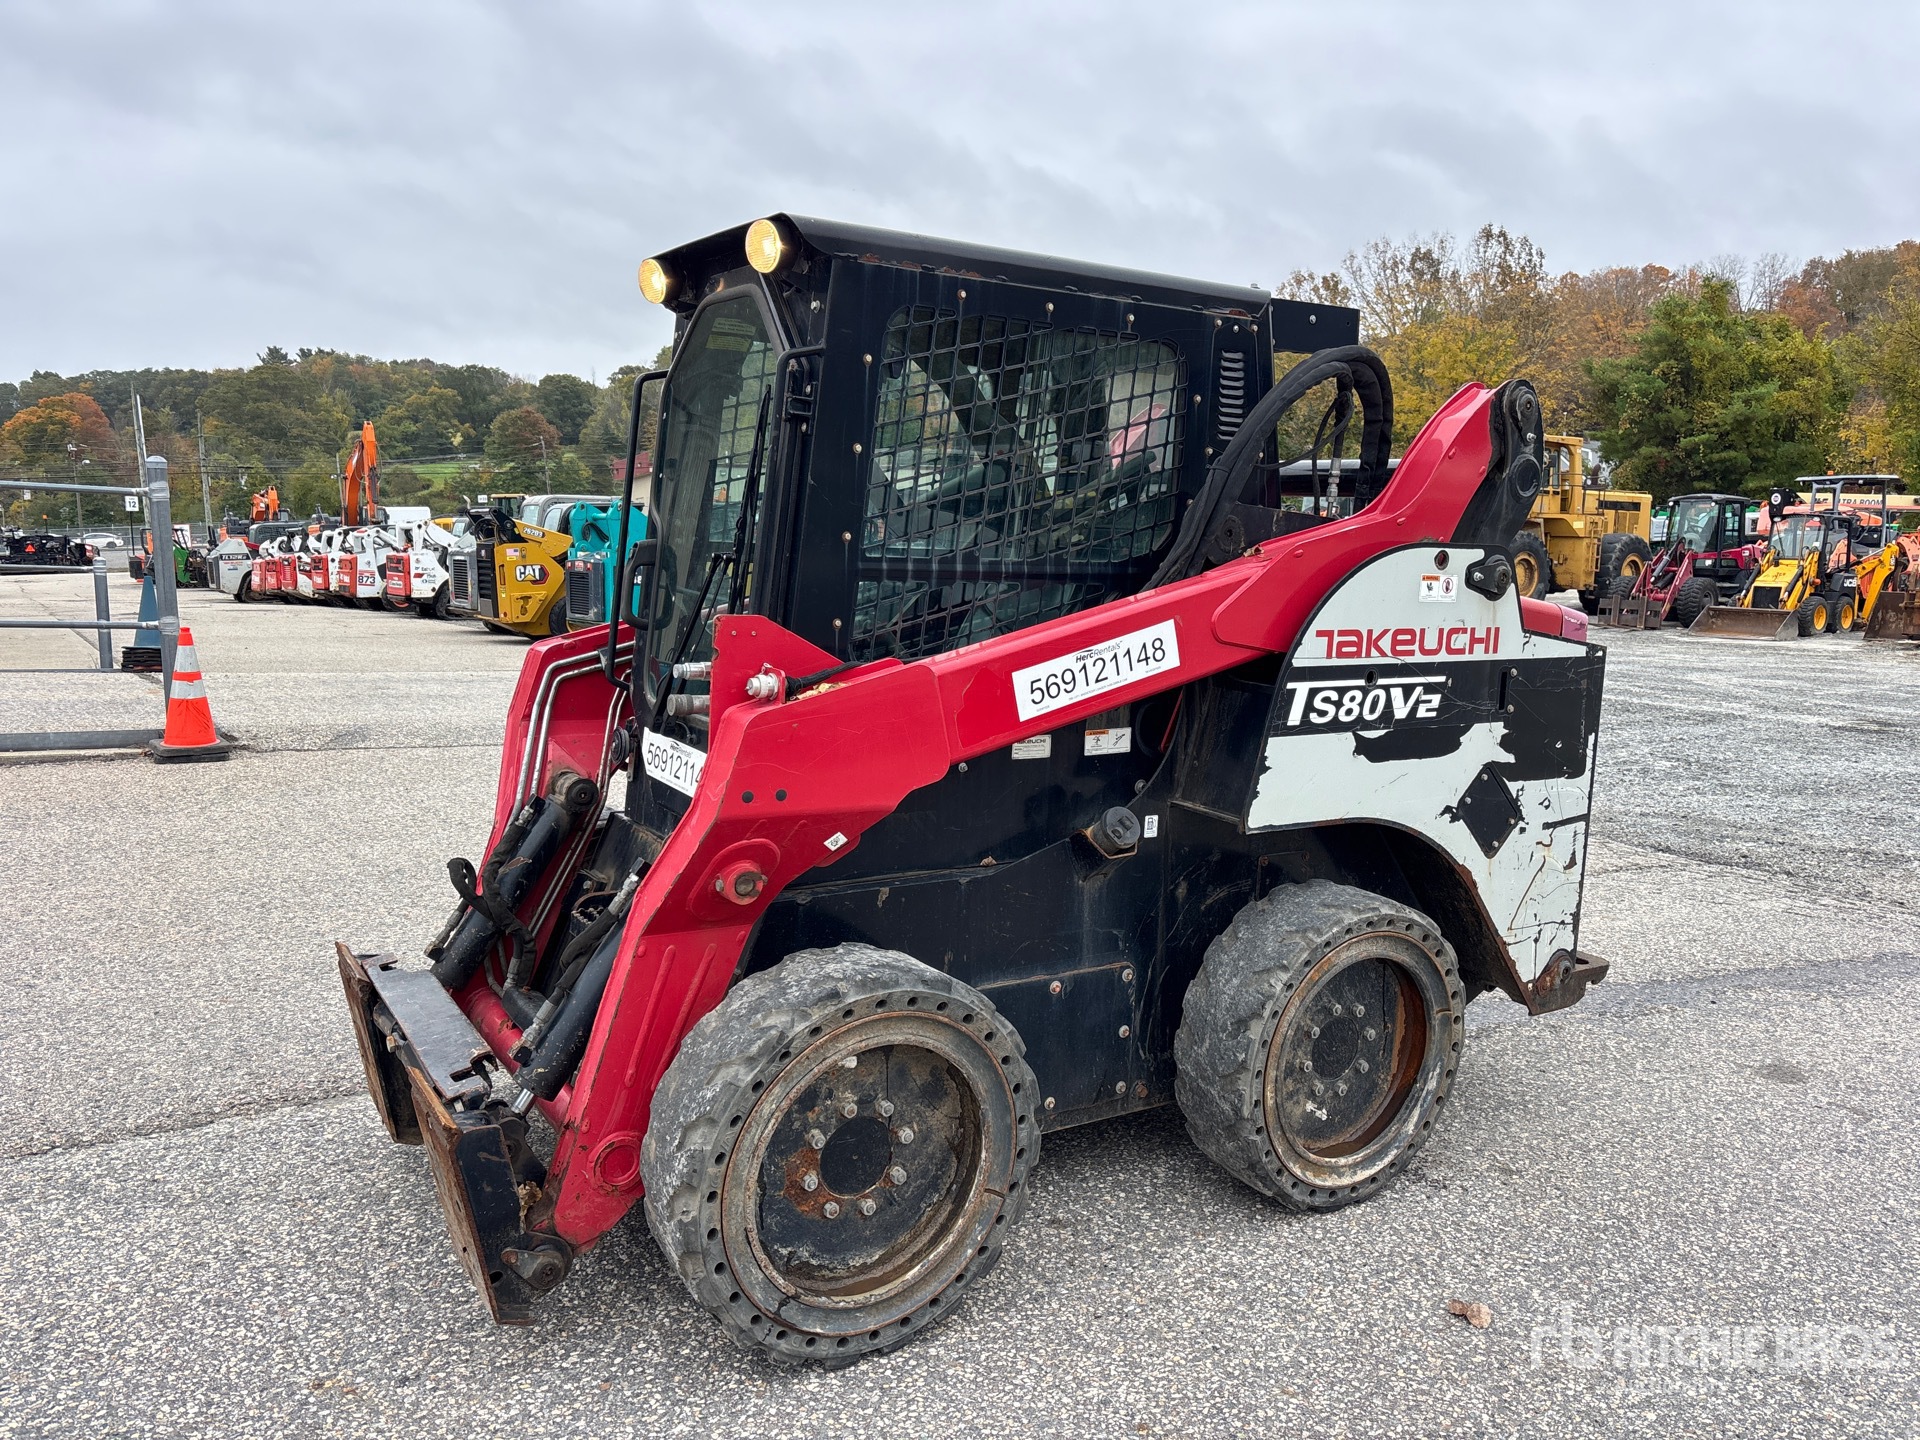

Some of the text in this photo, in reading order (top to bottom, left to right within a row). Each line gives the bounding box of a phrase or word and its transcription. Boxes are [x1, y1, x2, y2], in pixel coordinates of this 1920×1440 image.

[357, 575, 376, 584] 873
[516, 565, 542, 583] CAT
[1843, 578, 1858, 587] JCB
[1315, 626, 1501, 660] TAKEUCHI
[1029, 637, 1166, 705] 569121148
[1286, 675, 1447, 727] TS80V2
